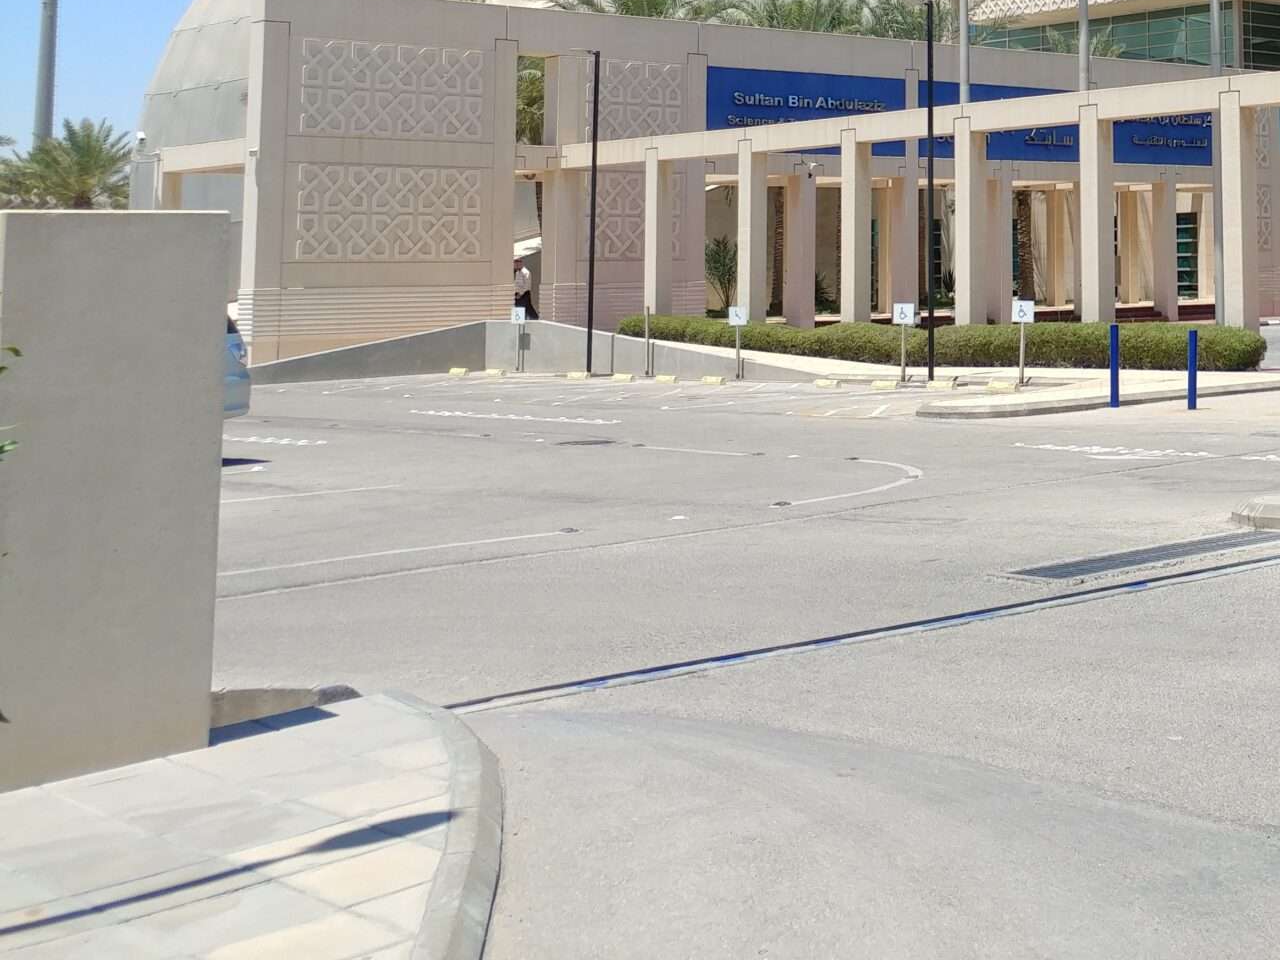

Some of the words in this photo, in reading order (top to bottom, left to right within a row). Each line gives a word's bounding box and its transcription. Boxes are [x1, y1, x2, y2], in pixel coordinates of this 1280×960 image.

[734, 92, 784, 106] Sultan
[788, 95, 813, 108] Bin
[816, 96, 888, 112] Abdulaziz
